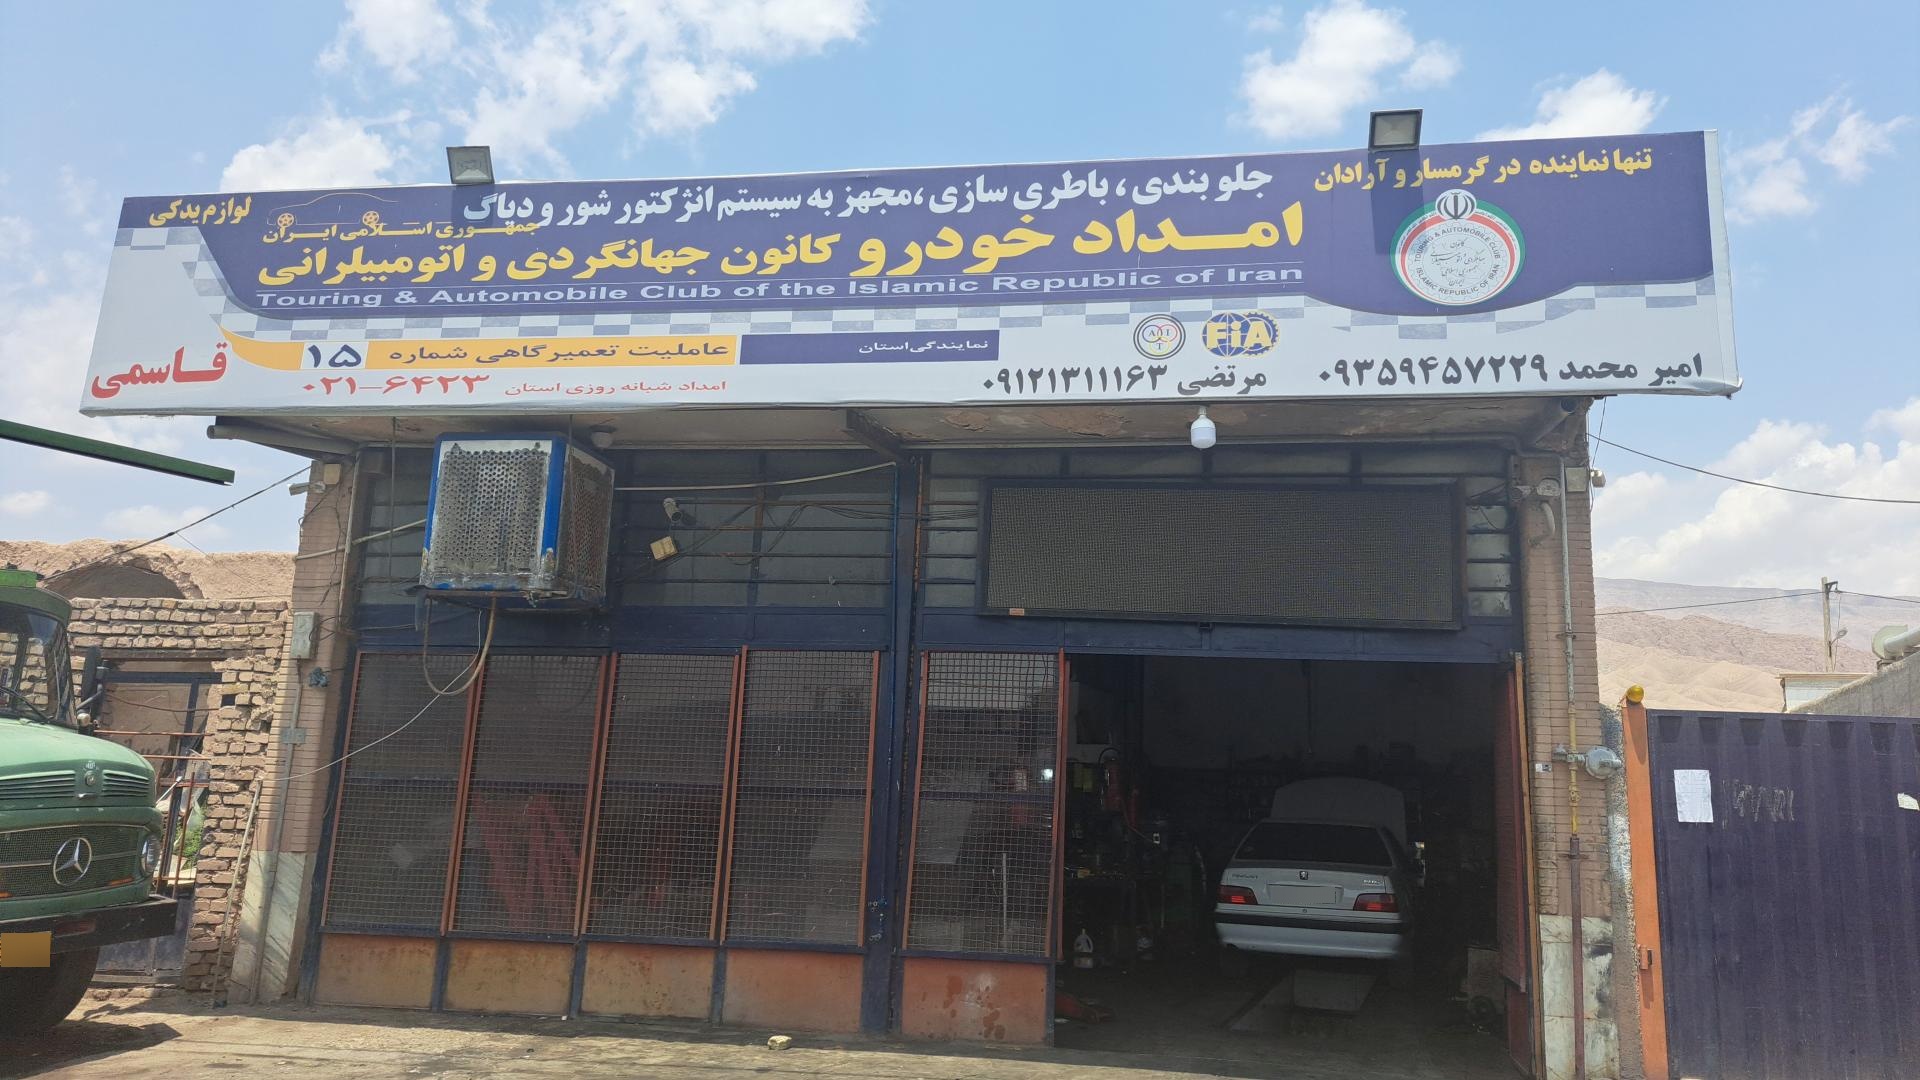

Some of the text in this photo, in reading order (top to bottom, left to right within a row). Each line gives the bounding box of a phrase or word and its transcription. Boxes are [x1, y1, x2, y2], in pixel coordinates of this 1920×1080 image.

[1314, 148, 1652, 192] تنها نماینده در گرمسار و آرادان
[614, 184, 714, 225] انژکتور
[717, 188, 802, 222] سیستم
[807, 187, 834, 217] به
[1013, 169, 1109, 211] باطری
[149, 196, 252, 227] لوازم یدکی
[463, 191, 534, 225] دیاگ
[536, 202, 553, 227] و
[556, 190, 611, 226] شور
[262, 221, 540, 243] جمهوری اسلامی ایران
[1073, 200, 1303, 254] امداد
[1441, 226, 1490, 241] AUTOMOBILE
[1489, 241, 1501, 259] CLUB
[258, 243, 465, 286] اتومبیلرانی
[471, 255, 497, 282] و
[506, 237, 710, 281] جهانگردی
[720, 233, 841, 275] کانون
[256, 266, 1303, 308] Touring & Automobile Club of the Islamic Republic of Iran
[1416, 264, 1500, 296] ISLAMIC REPUBLIC OF IRAN
[308, 344, 362, 369] ۱۵
[390, 346, 467, 364] شماره
[629, 342, 729, 360] عاملیت
[858, 340, 988, 354] نمایندگی استان
[91, 341, 228, 399] قاسمی
[983, 364, 1267, 396] مرتضی ۰۹۱۲۱۳۱۱۱۶۳
[1319, 352, 1702, 387] امیر محمد ۰۹۳۵۹۴۵۷۲۲۹
[504, 381, 727, 396] امداد شبانه روزی استان
